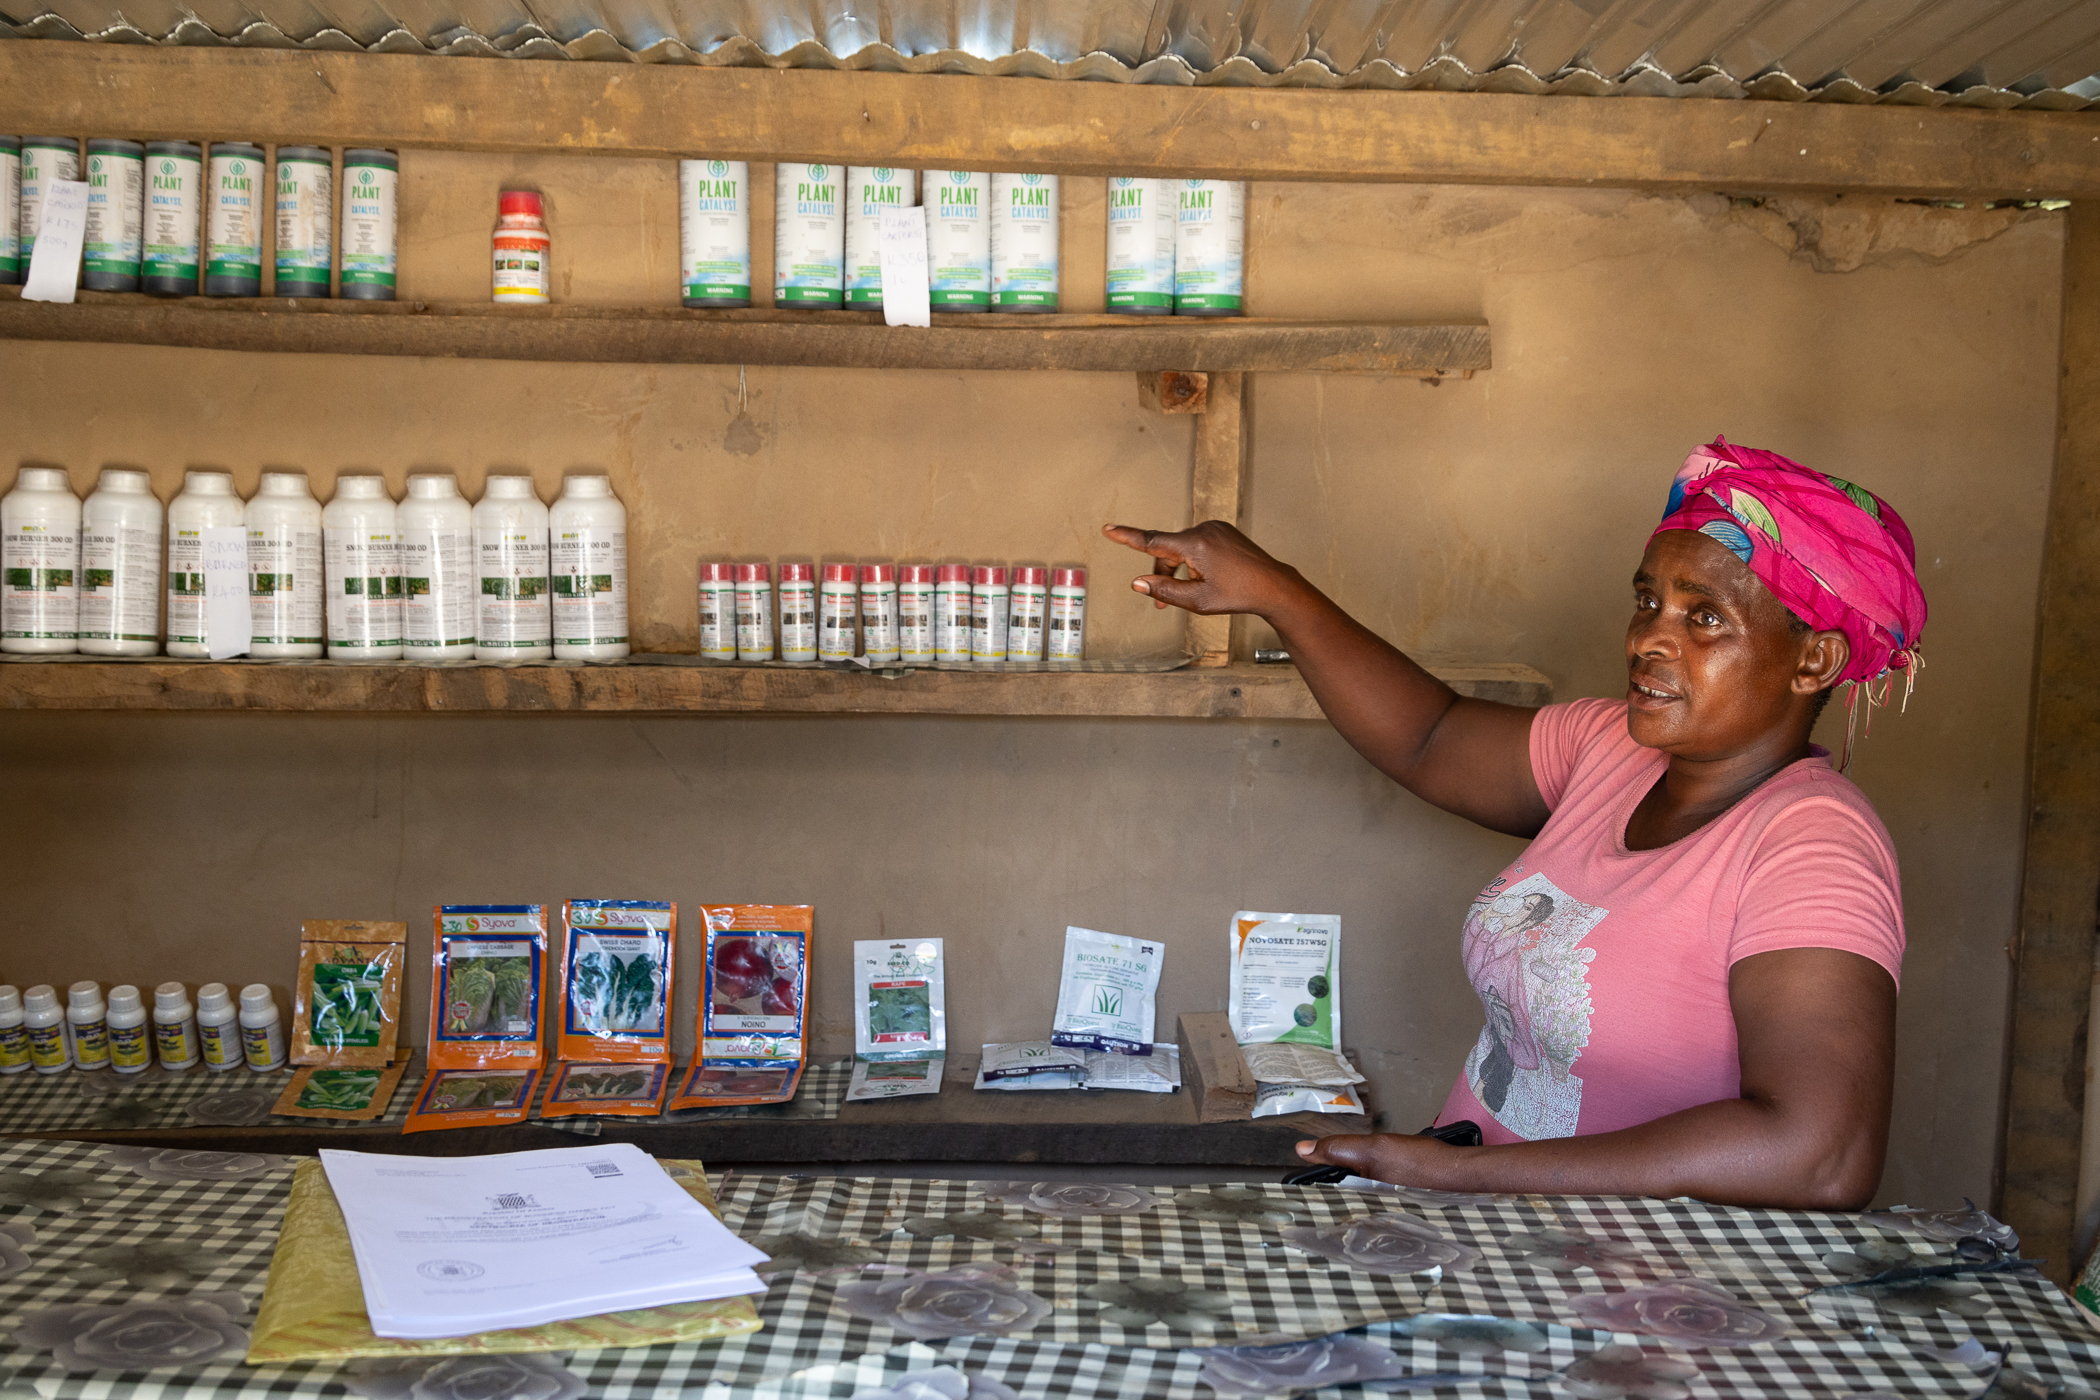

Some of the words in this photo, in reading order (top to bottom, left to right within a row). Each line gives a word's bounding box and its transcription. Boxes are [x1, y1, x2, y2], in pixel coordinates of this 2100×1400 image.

[153, 175, 183, 191] PLANT
[222, 175, 252, 192] PLANT
[699, 180, 737, 199] PLANT
[352, 186, 381, 200] PLANT
[798, 183, 836, 203] PLANT
[863, 184, 901, 204] PLANT
[941, 187, 979, 205] PLANT
[1012, 188, 1050, 206] PLANT
[1110, 188, 1143, 208] PLANT
[1180, 190, 1213, 209] PLANT
[93, 535, 105, 543] 300
[209, 541, 245, 554] SNOW
[481, 917, 515, 930] Syova
[610, 911, 644, 925] Syova
[1249, 936, 1294, 945] NOVOSATE
[1077, 953, 1119, 965] BIOSATE
[1122, 959, 1132, 969] 71
[1135, 962, 1147, 973] SG
[741, 1020, 767, 1028] ONION
